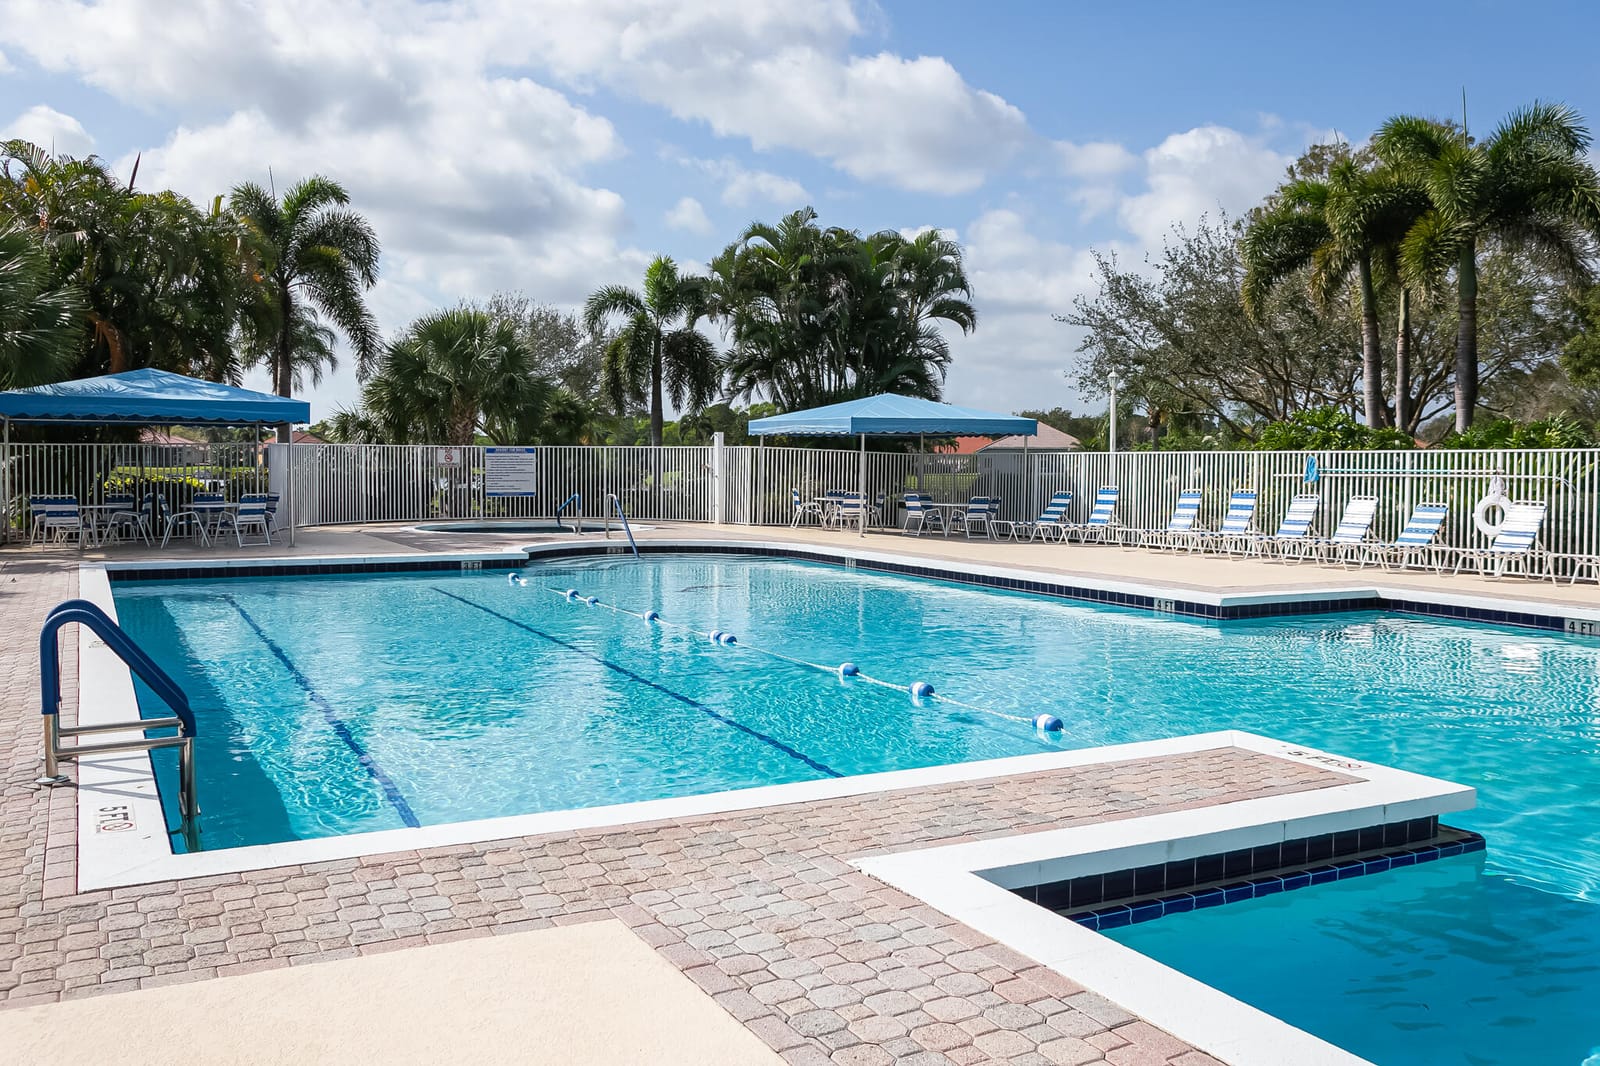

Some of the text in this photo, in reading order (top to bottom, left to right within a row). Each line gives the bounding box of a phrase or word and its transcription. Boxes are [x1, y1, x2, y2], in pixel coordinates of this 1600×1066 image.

[1157, 599, 1173, 611] 4 FT
[1569, 621, 1594, 633] 4 FT
